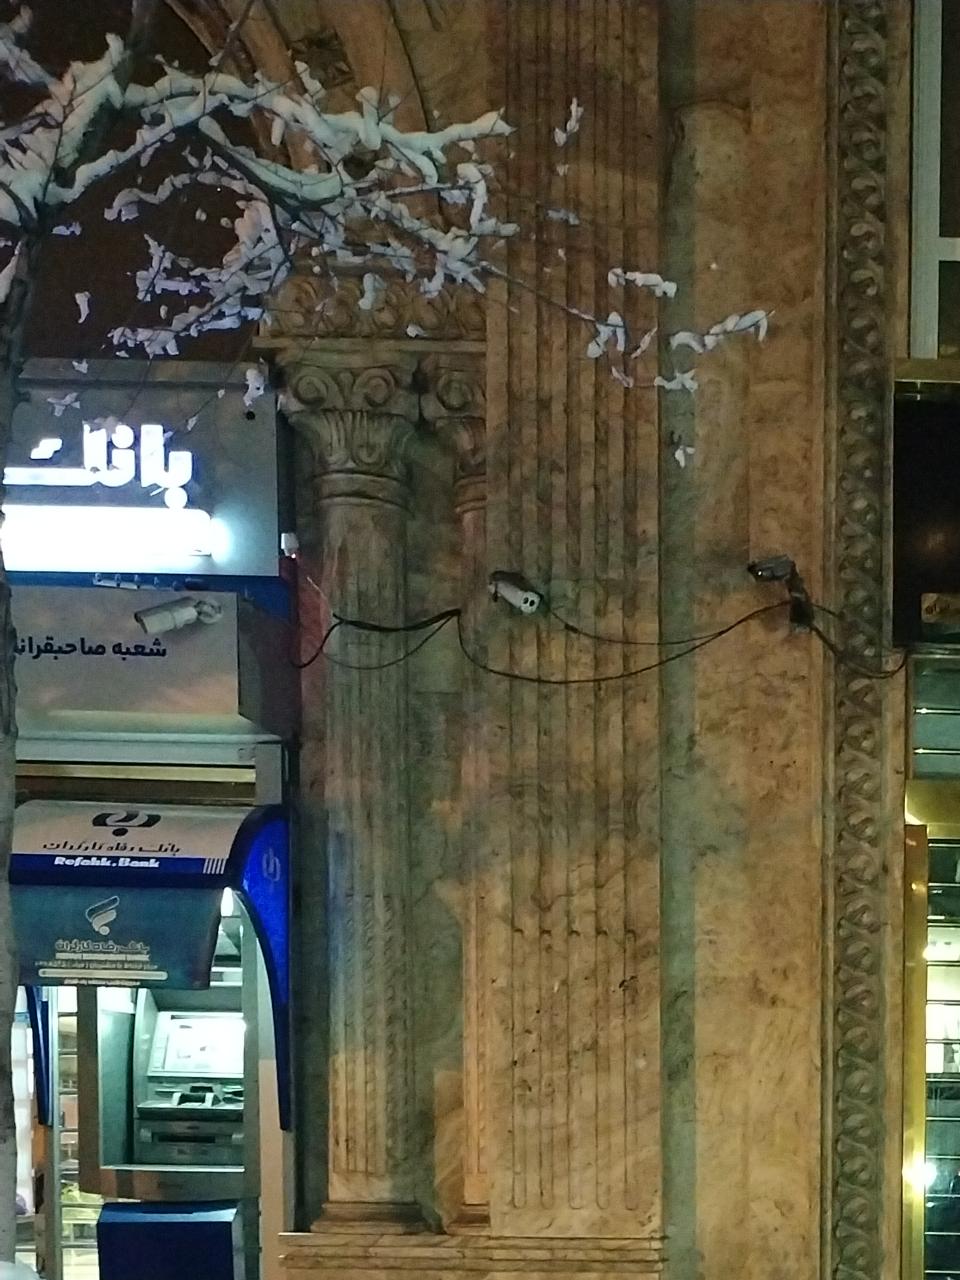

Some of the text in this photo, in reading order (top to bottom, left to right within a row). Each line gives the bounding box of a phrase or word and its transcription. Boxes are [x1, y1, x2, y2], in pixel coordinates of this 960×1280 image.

[2, 423, 193, 510] بانک
[112, 637, 167, 661] شعبه
[138, 842, 181, 856] بانک
